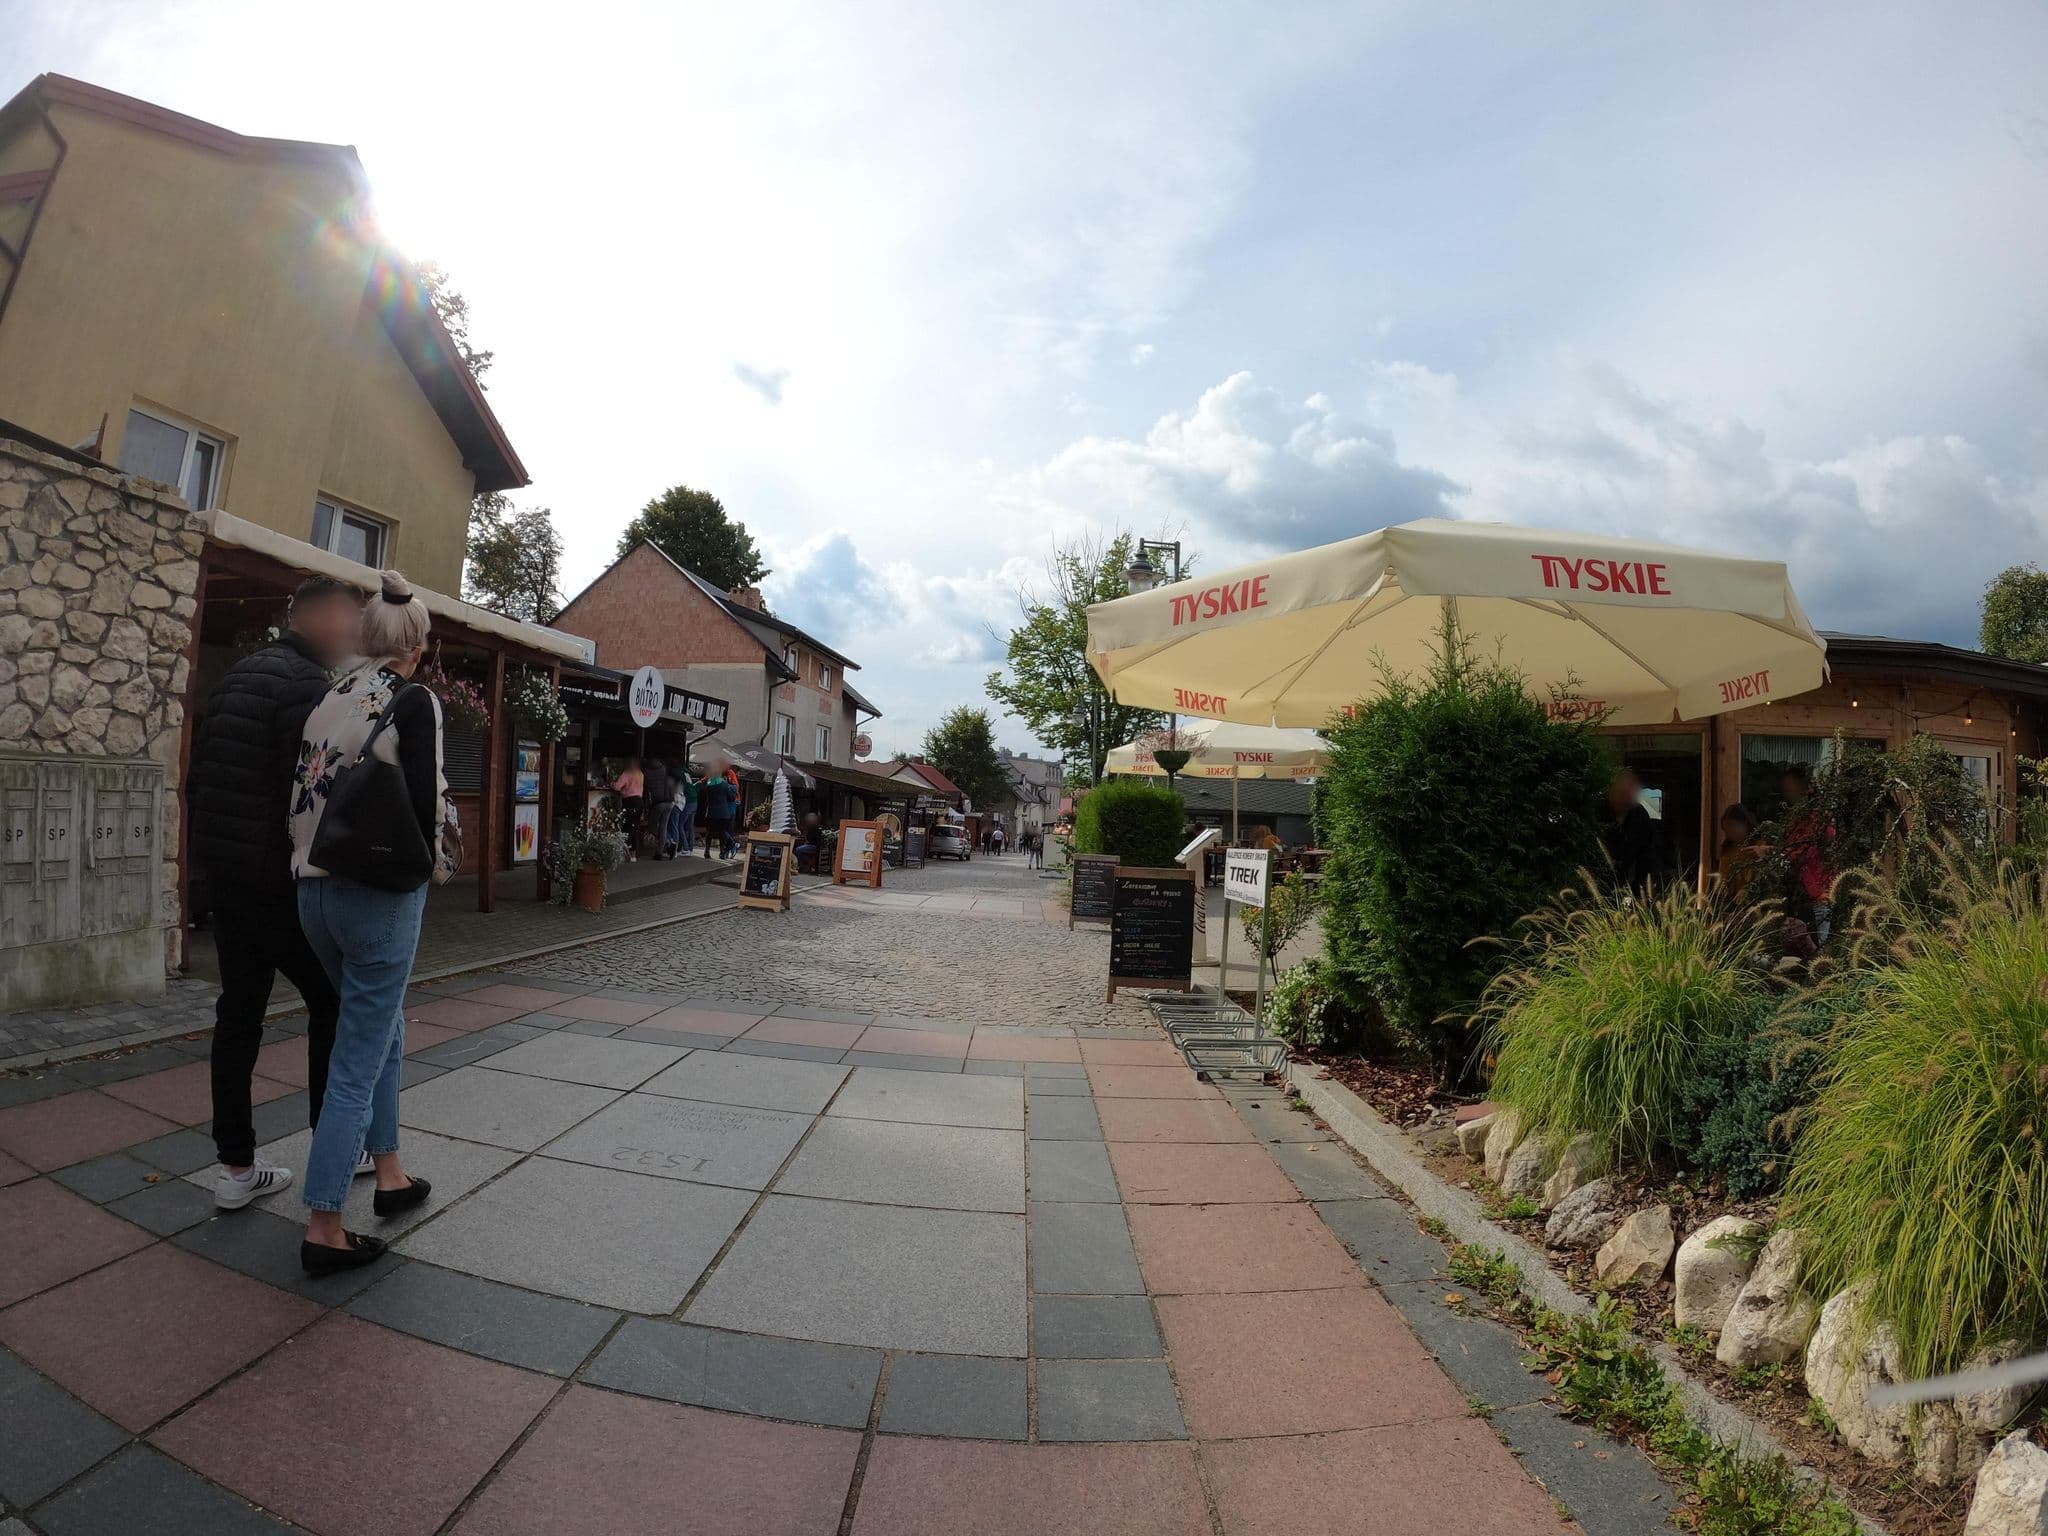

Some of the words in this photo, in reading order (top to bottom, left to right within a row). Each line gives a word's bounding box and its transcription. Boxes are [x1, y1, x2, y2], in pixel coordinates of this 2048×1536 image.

[1531, 554, 1672, 595] TYSKIE
[1169, 574, 1270, 626] TYSKIE
[635, 687, 659, 710] BISTRO
[668, 692, 685, 714] LODY
[1233, 751, 1274, 763] TYSKIE
[1230, 866, 1260, 886] TREK
[611, 1146, 714, 1173] 1532
